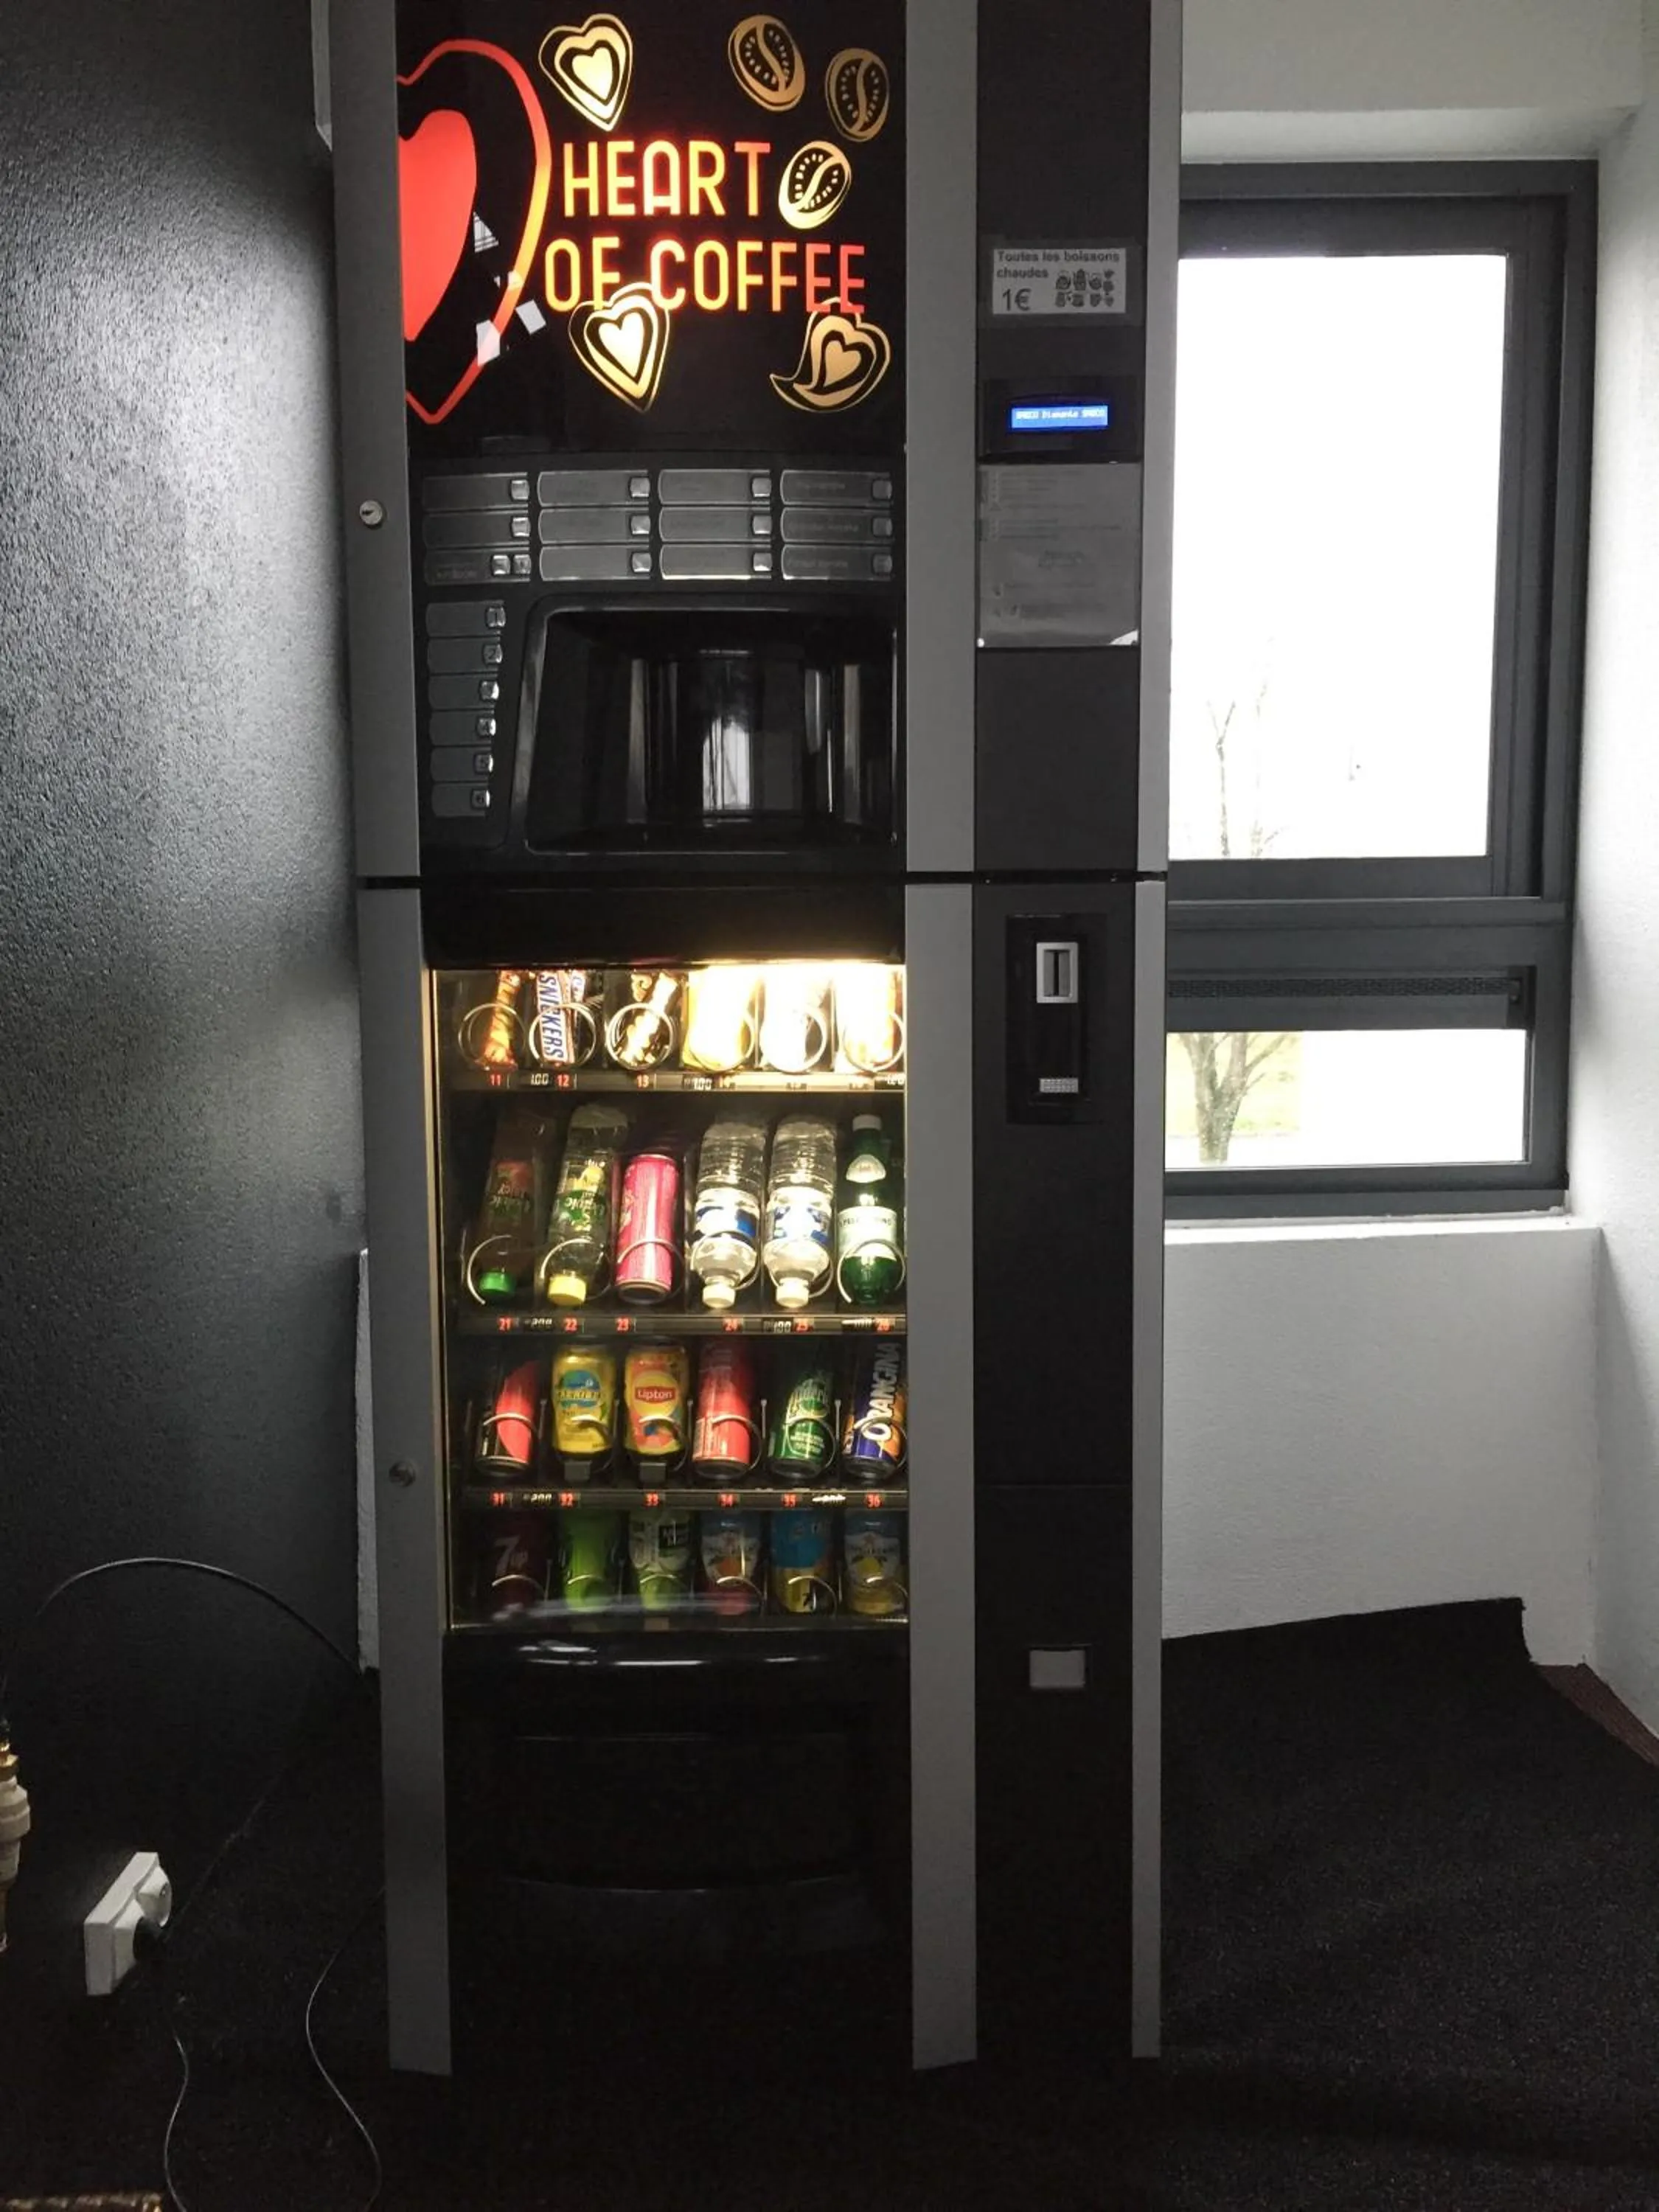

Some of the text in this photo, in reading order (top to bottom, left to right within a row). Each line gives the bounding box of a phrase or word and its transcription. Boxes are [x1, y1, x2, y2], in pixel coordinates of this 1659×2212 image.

[563, 139, 771, 217] HEART
[998, 250, 1121, 262] Toutes les boissons
[544, 236, 866, 314] OF COFFEE
[997, 267, 1048, 279] chaudes
[1002, 288, 1032, 311] 1€
[539, 974, 565, 1059] SNICKERS
[557, 1074, 569, 1087] 12
[564, 1318, 577, 1331] 22
[637, 1388, 673, 1401] Lipton
[866, 1494, 881, 1507] 36
